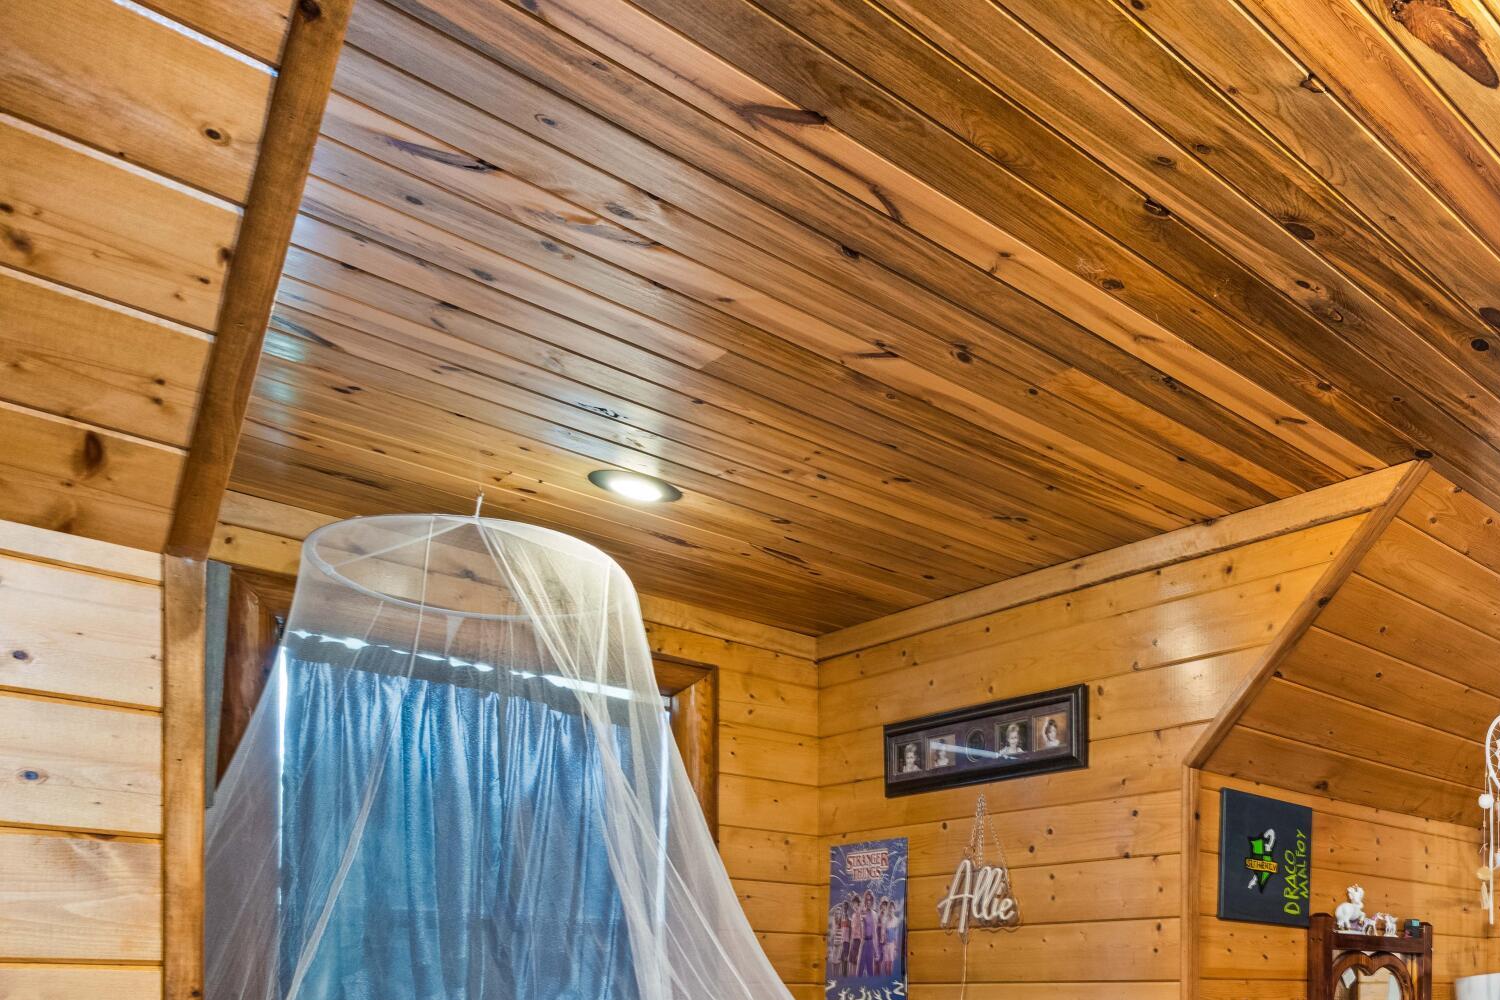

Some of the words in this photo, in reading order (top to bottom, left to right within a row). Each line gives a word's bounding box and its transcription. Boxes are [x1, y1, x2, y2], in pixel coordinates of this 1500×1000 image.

[847, 850, 889, 872] STRANGER
[853, 866, 880, 881] THINGS
[1284, 849, 1301, 916] DRACO
[1296, 828, 1309, 899] MALFOY
[936, 859, 1016, 934] Allie
